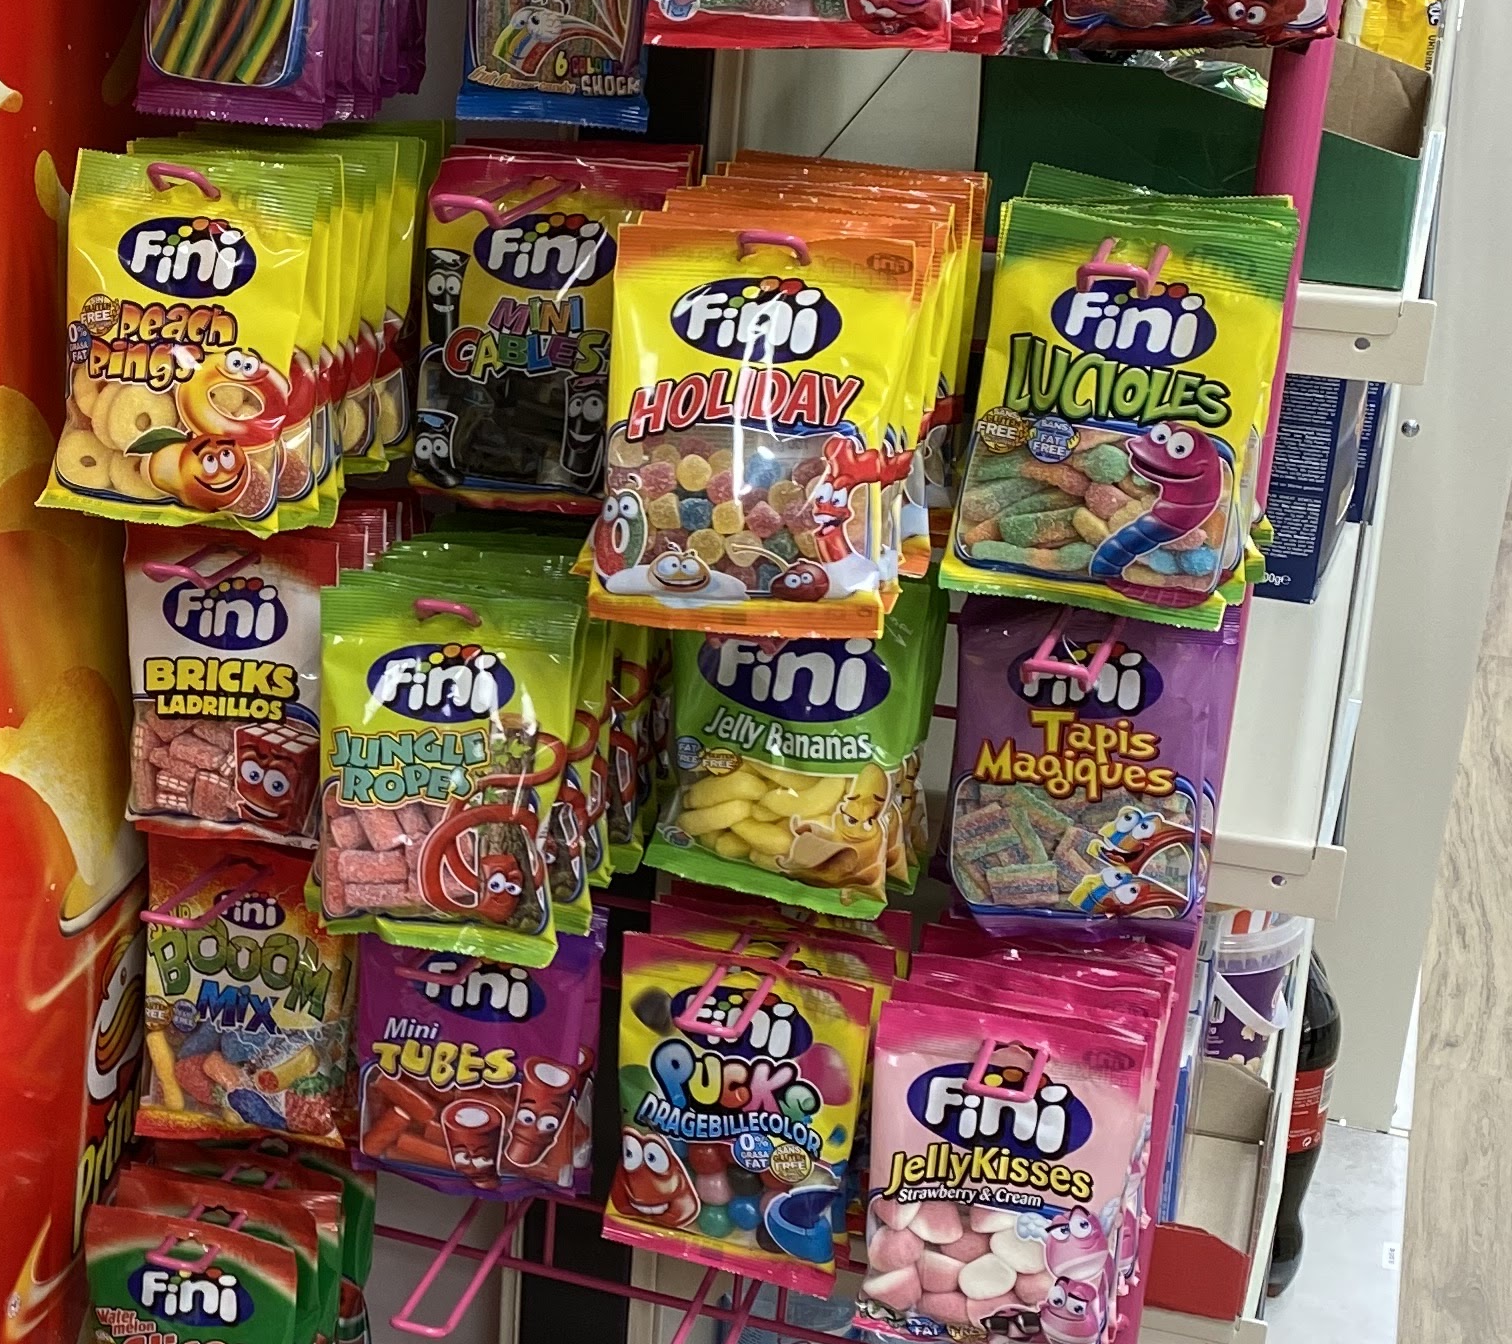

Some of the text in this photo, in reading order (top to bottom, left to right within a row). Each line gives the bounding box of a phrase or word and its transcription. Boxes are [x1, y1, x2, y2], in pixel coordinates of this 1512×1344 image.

[132, 227, 243, 291] Fini
[487, 222, 601, 281] Fini
[489, 295, 583, 335] MINI
[685, 287, 822, 356] Fini
[1064, 290, 1205, 360] Fini
[446, 330, 611, 383] CABLES
[1003, 332, 1234, 428] LUCIOLES
[626, 369, 862, 441] HOLIDAY
[174, 585, 278, 643] Fini
[144, 657, 297, 699] BRICKS
[383, 652, 500, 714] Fini
[714, 637, 874, 713] Fini
[1023, 651, 1143, 712] Fini
[156, 695, 284, 722] LADRILLOS
[702, 706, 874, 762] Jelly Bananas
[1030, 708, 1160, 760] Tapis
[330, 728, 490, 768] JUNGLE
[975, 739, 1178, 801] Magiques
[341, 766, 474, 803] ROPES
[425, 960, 530, 1018] Fini
[384, 1016, 440, 1041] Mini
[691, 994, 796, 1060] Fini
[372, 1041, 518, 1086] TUBES
[925, 1076, 1071, 1154] Fini
[897, 1184, 1042, 1210] Strawberry Cream
[96, 1307, 137, 1325] Water
[140, 1270, 238, 1323] Fini
[111, 1320, 157, 1337] melon
